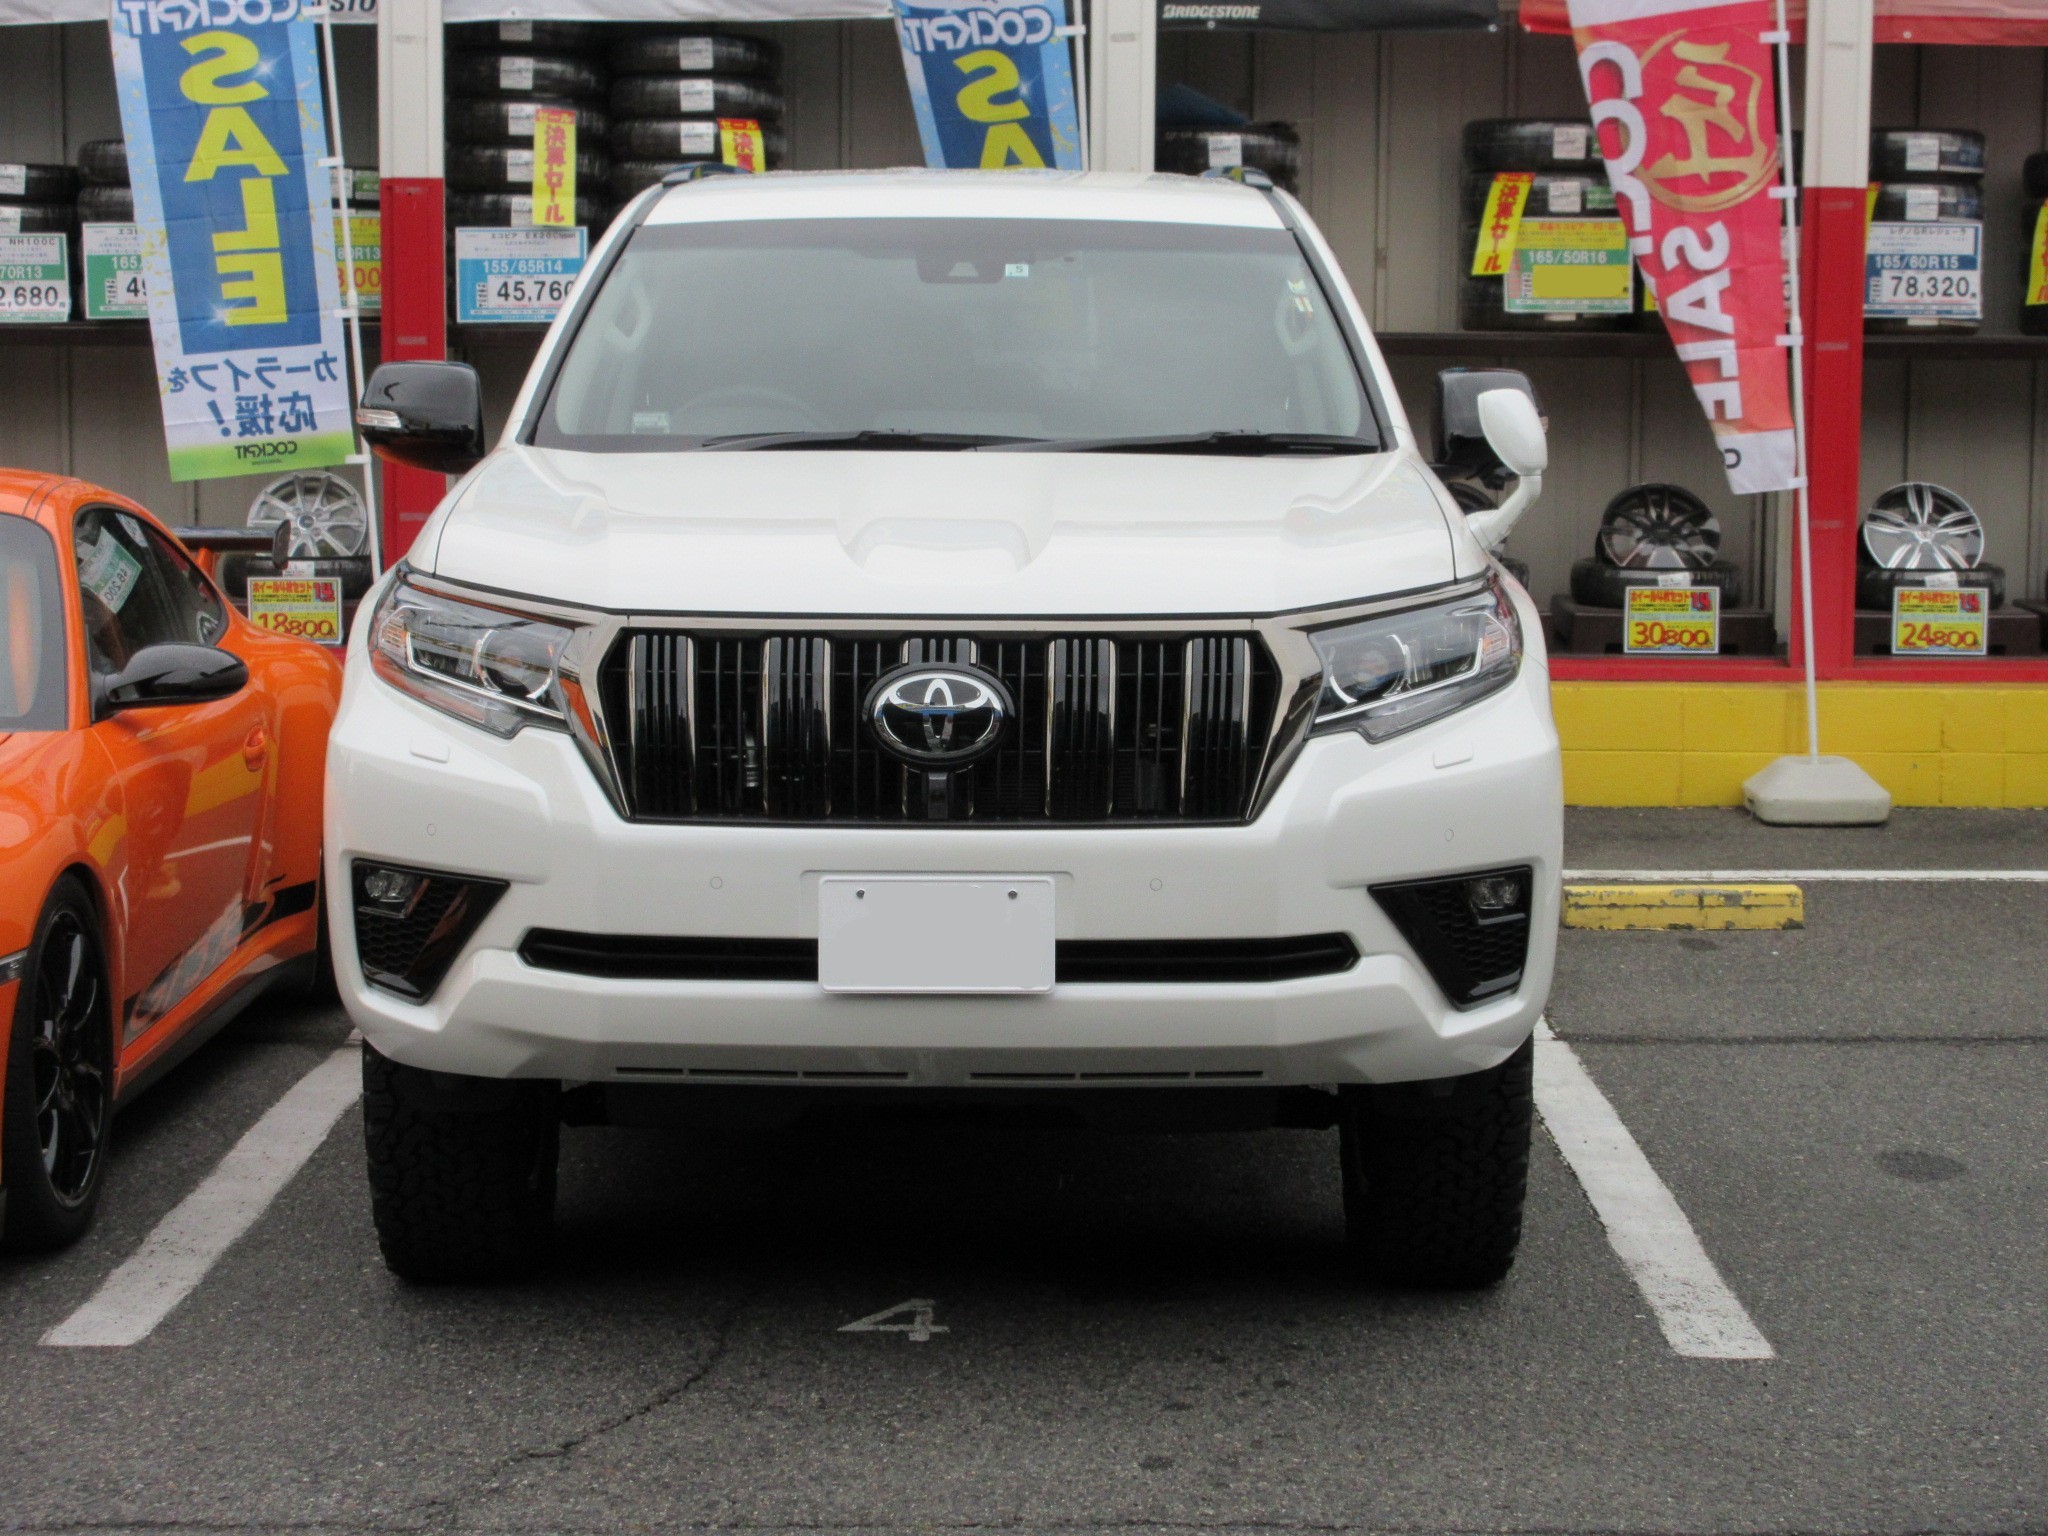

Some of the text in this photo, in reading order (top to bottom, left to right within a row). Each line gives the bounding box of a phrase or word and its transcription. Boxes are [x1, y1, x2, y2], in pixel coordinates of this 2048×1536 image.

[1163, 4, 1260, 19] BRIDGESTONE
[483, 260, 562, 273] 155/65R14
[1875, 256, 1959, 268] 165/60R15
[837, 1299, 950, 1341] 4
